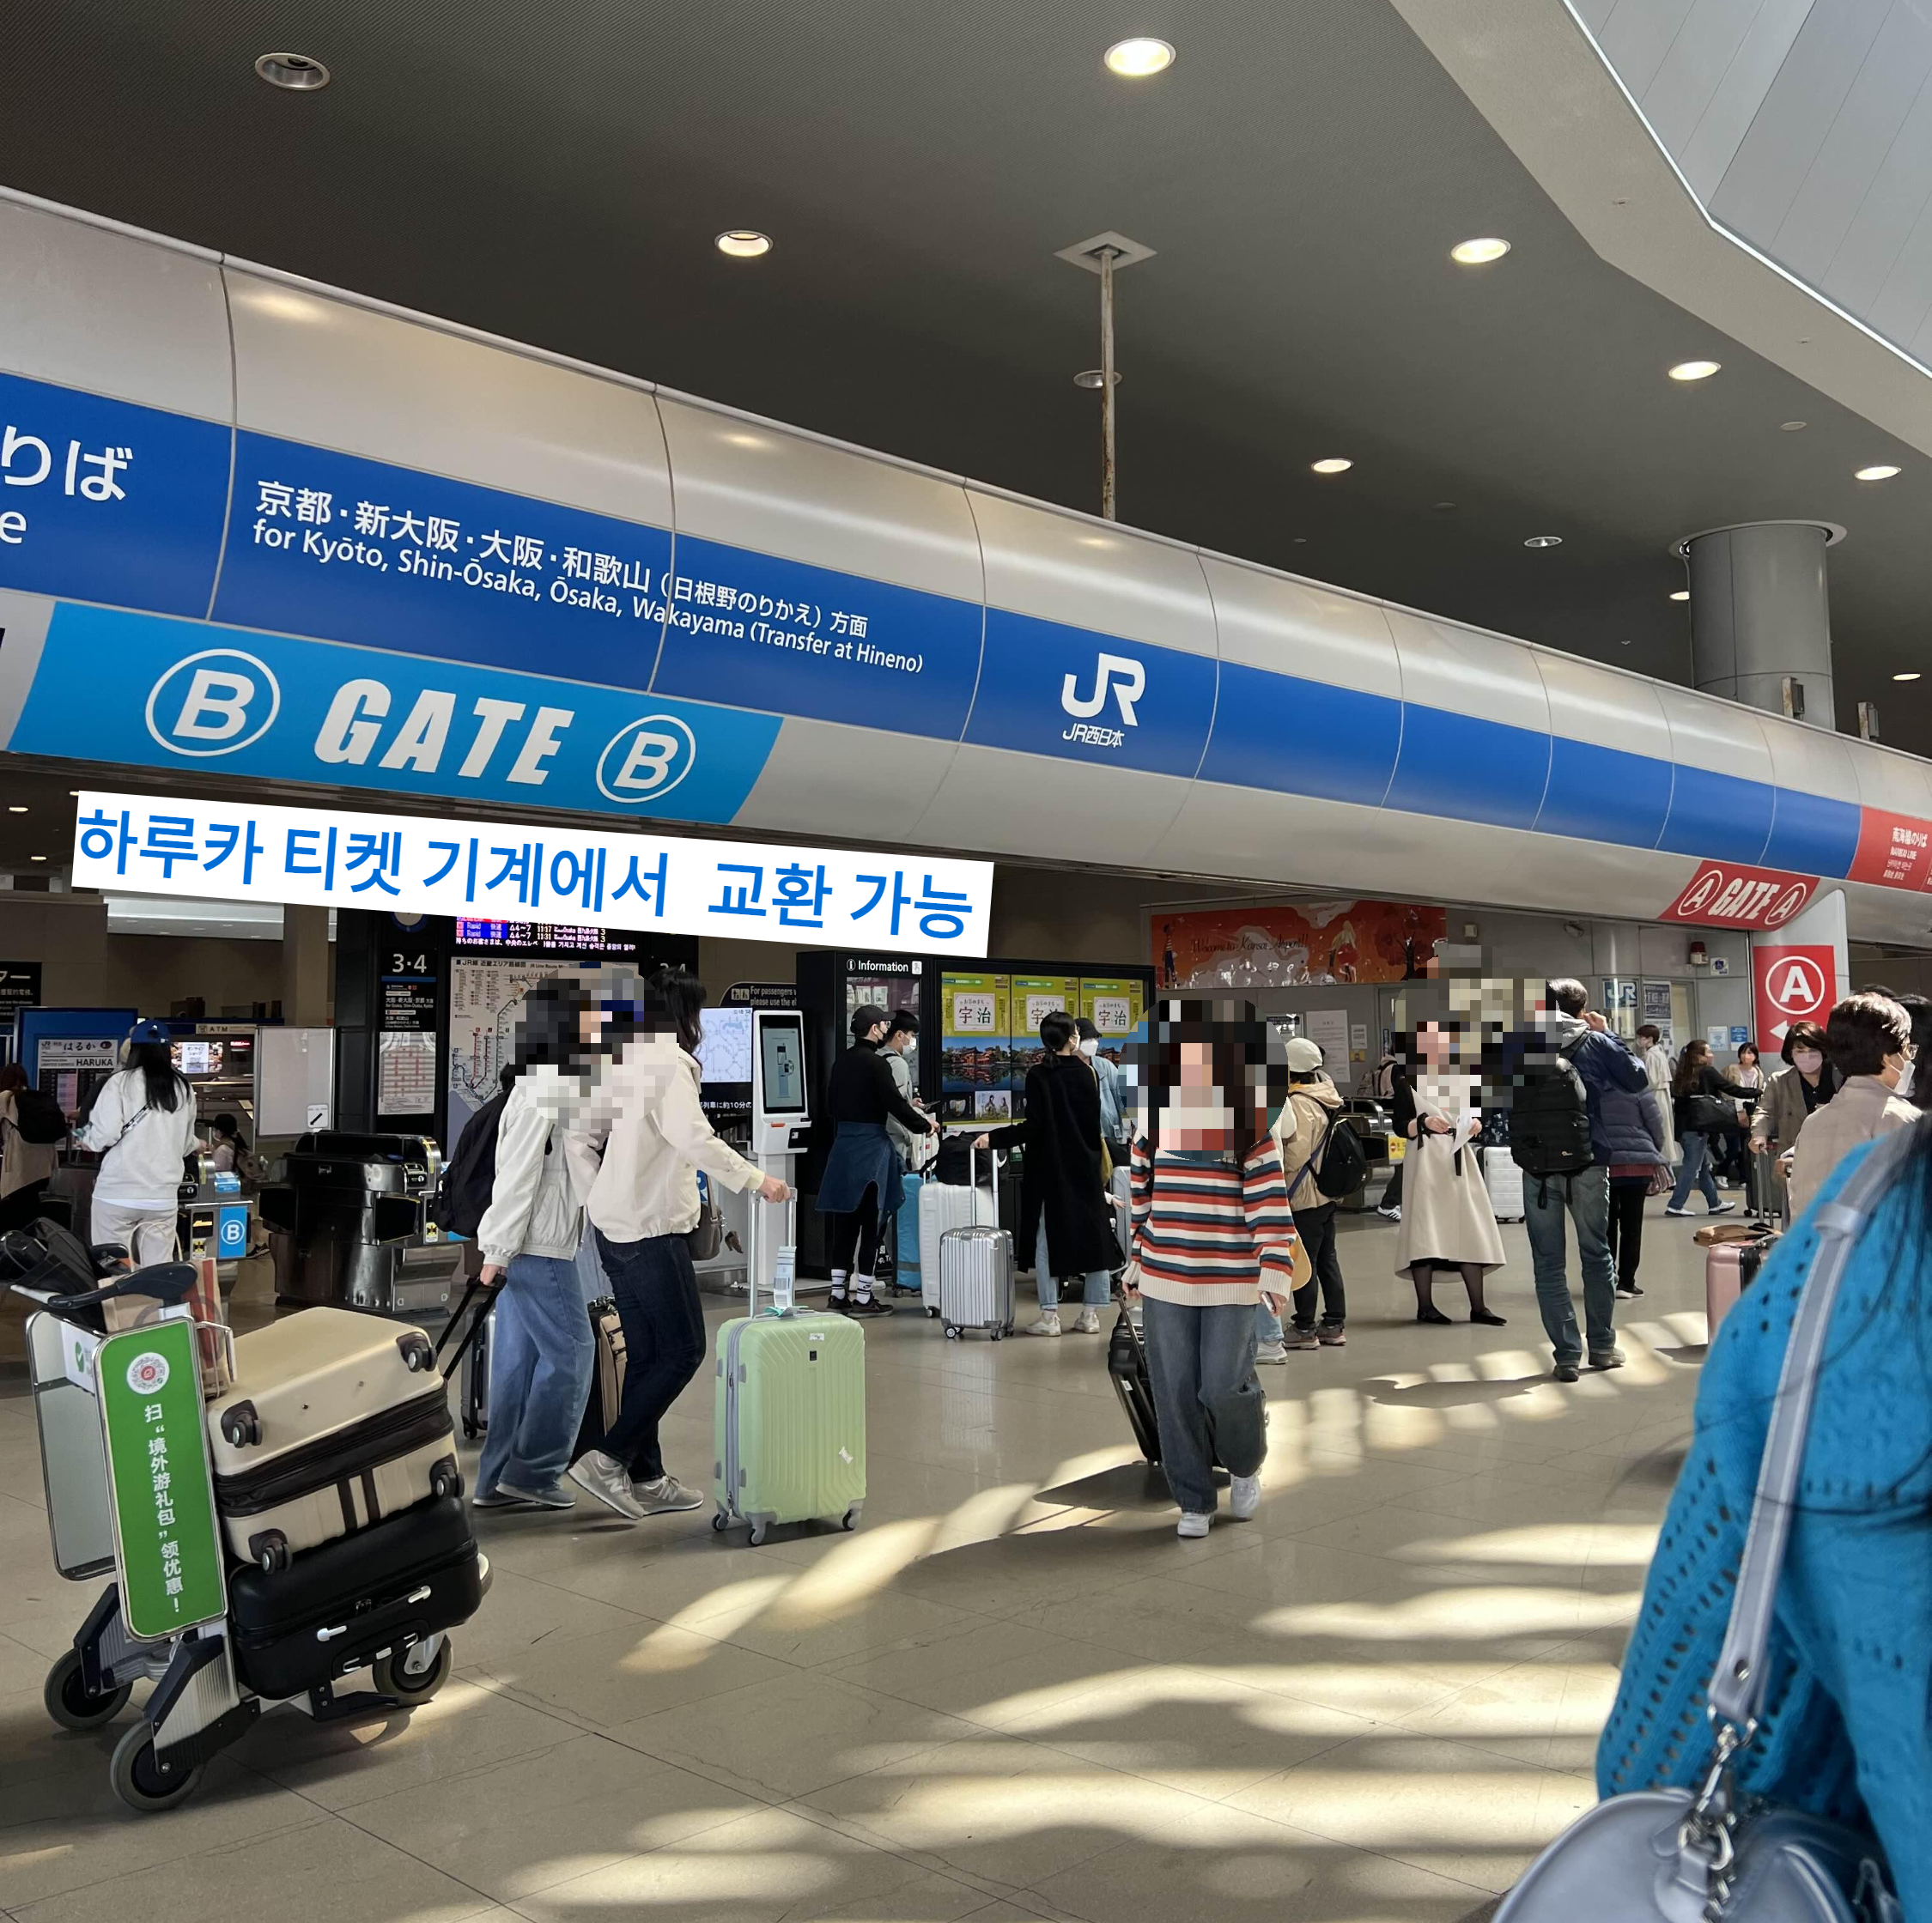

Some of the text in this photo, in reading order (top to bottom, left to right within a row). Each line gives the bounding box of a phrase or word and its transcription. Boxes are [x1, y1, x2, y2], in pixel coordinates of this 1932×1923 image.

[1, 425, 133, 501] りば
[253, 519, 923, 673] for Kyōto, Shin-Ōsaka, Ōsaka, Wakayama (Transfer at Hineno)
[1061, 652, 1146, 727] JR
[173, 670, 678, 789] B GATE B
[1062, 723, 1125, 749] JR西日本
[1708, 877, 1781, 920] GATE
[858, 959, 908, 973] Information
[750, 986, 760, 995] For
[762, 988, 793, 998] passengers
[1607, 982, 1637, 1000] JR
[1778, 965, 1815, 1003] A
[750, 997, 769, 1006] please
[781, 998, 790, 1006] the
[958, 1006, 992, 1024] 宇治
[1098, 1010, 1127, 1027] 宇治
[64, 1041, 96, 1051] はるか
